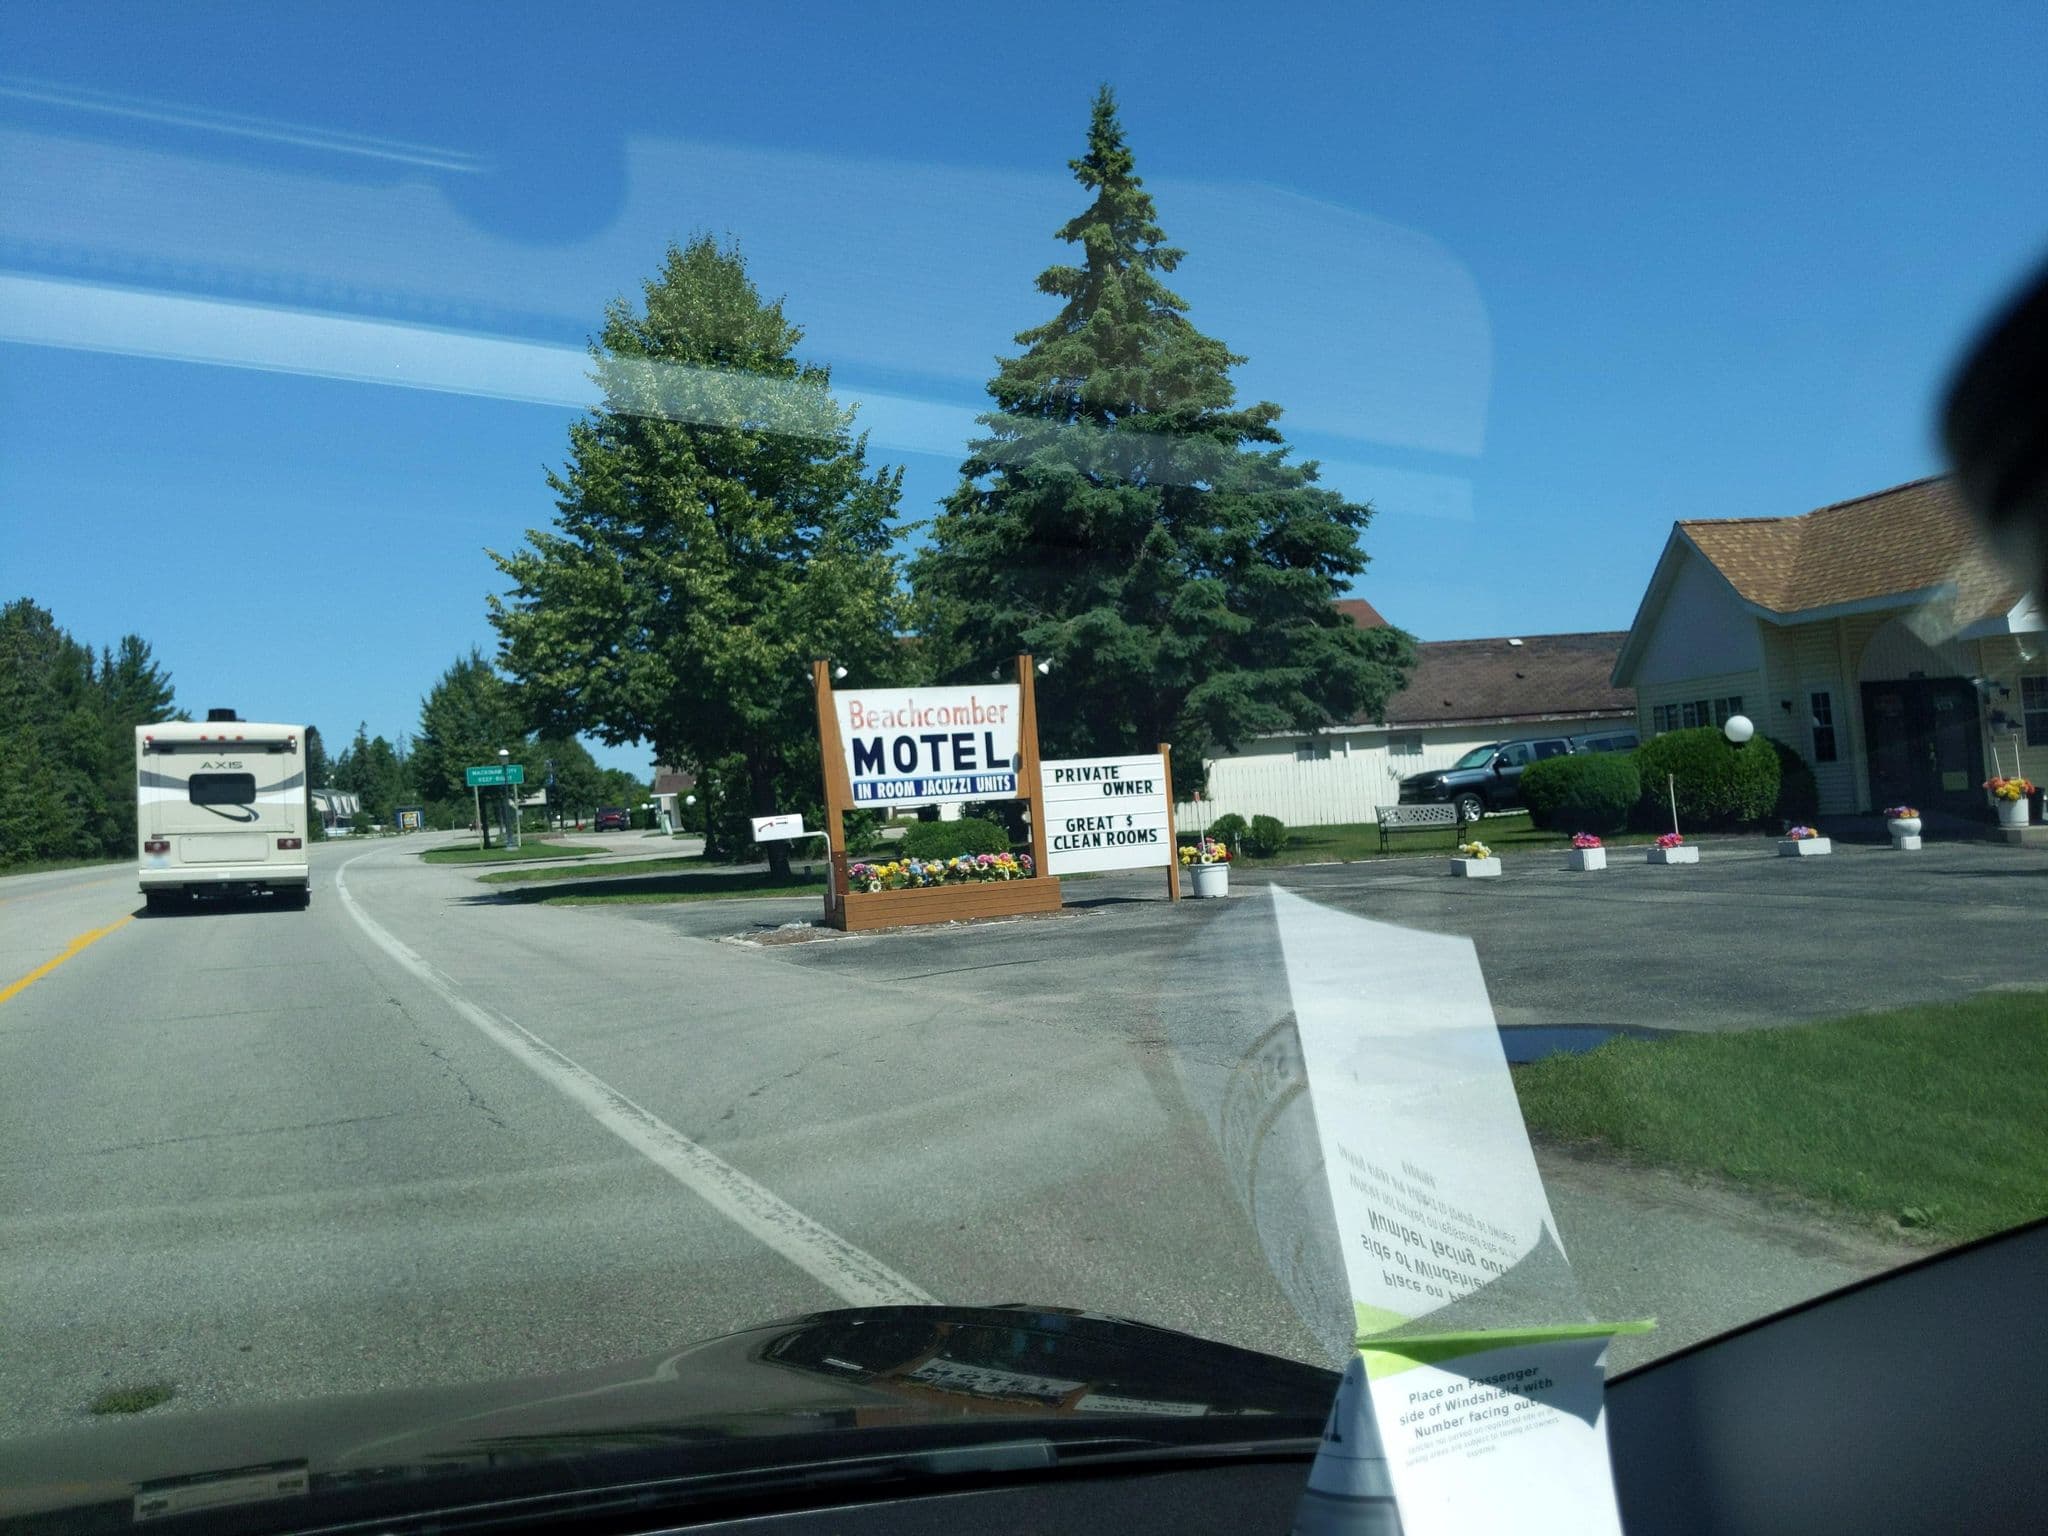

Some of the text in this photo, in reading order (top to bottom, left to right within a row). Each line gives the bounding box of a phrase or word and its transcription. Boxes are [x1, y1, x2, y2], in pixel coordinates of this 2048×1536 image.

[849, 696, 1008, 729] Beachcomber
[201, 761, 243, 769] AXIS
[852, 732, 1011, 776] MOTEL
[1055, 766, 1119, 782] PRIVATE
[858, 775, 1011, 799] IN ROOM JACUZZI UNITS
[1103, 780, 1154, 796] OWNER
[1066, 814, 1133, 833] GREAT $
[1054, 829, 1158, 850] CLEAN ROOMS
[1409, 1367, 1539, 1405] Place on Passenger
[1400, 1378, 1553, 1426] side of Windshield with
[1415, 1417, 1464, 1440] Number
[1469, 1404, 1509, 1423] facing
